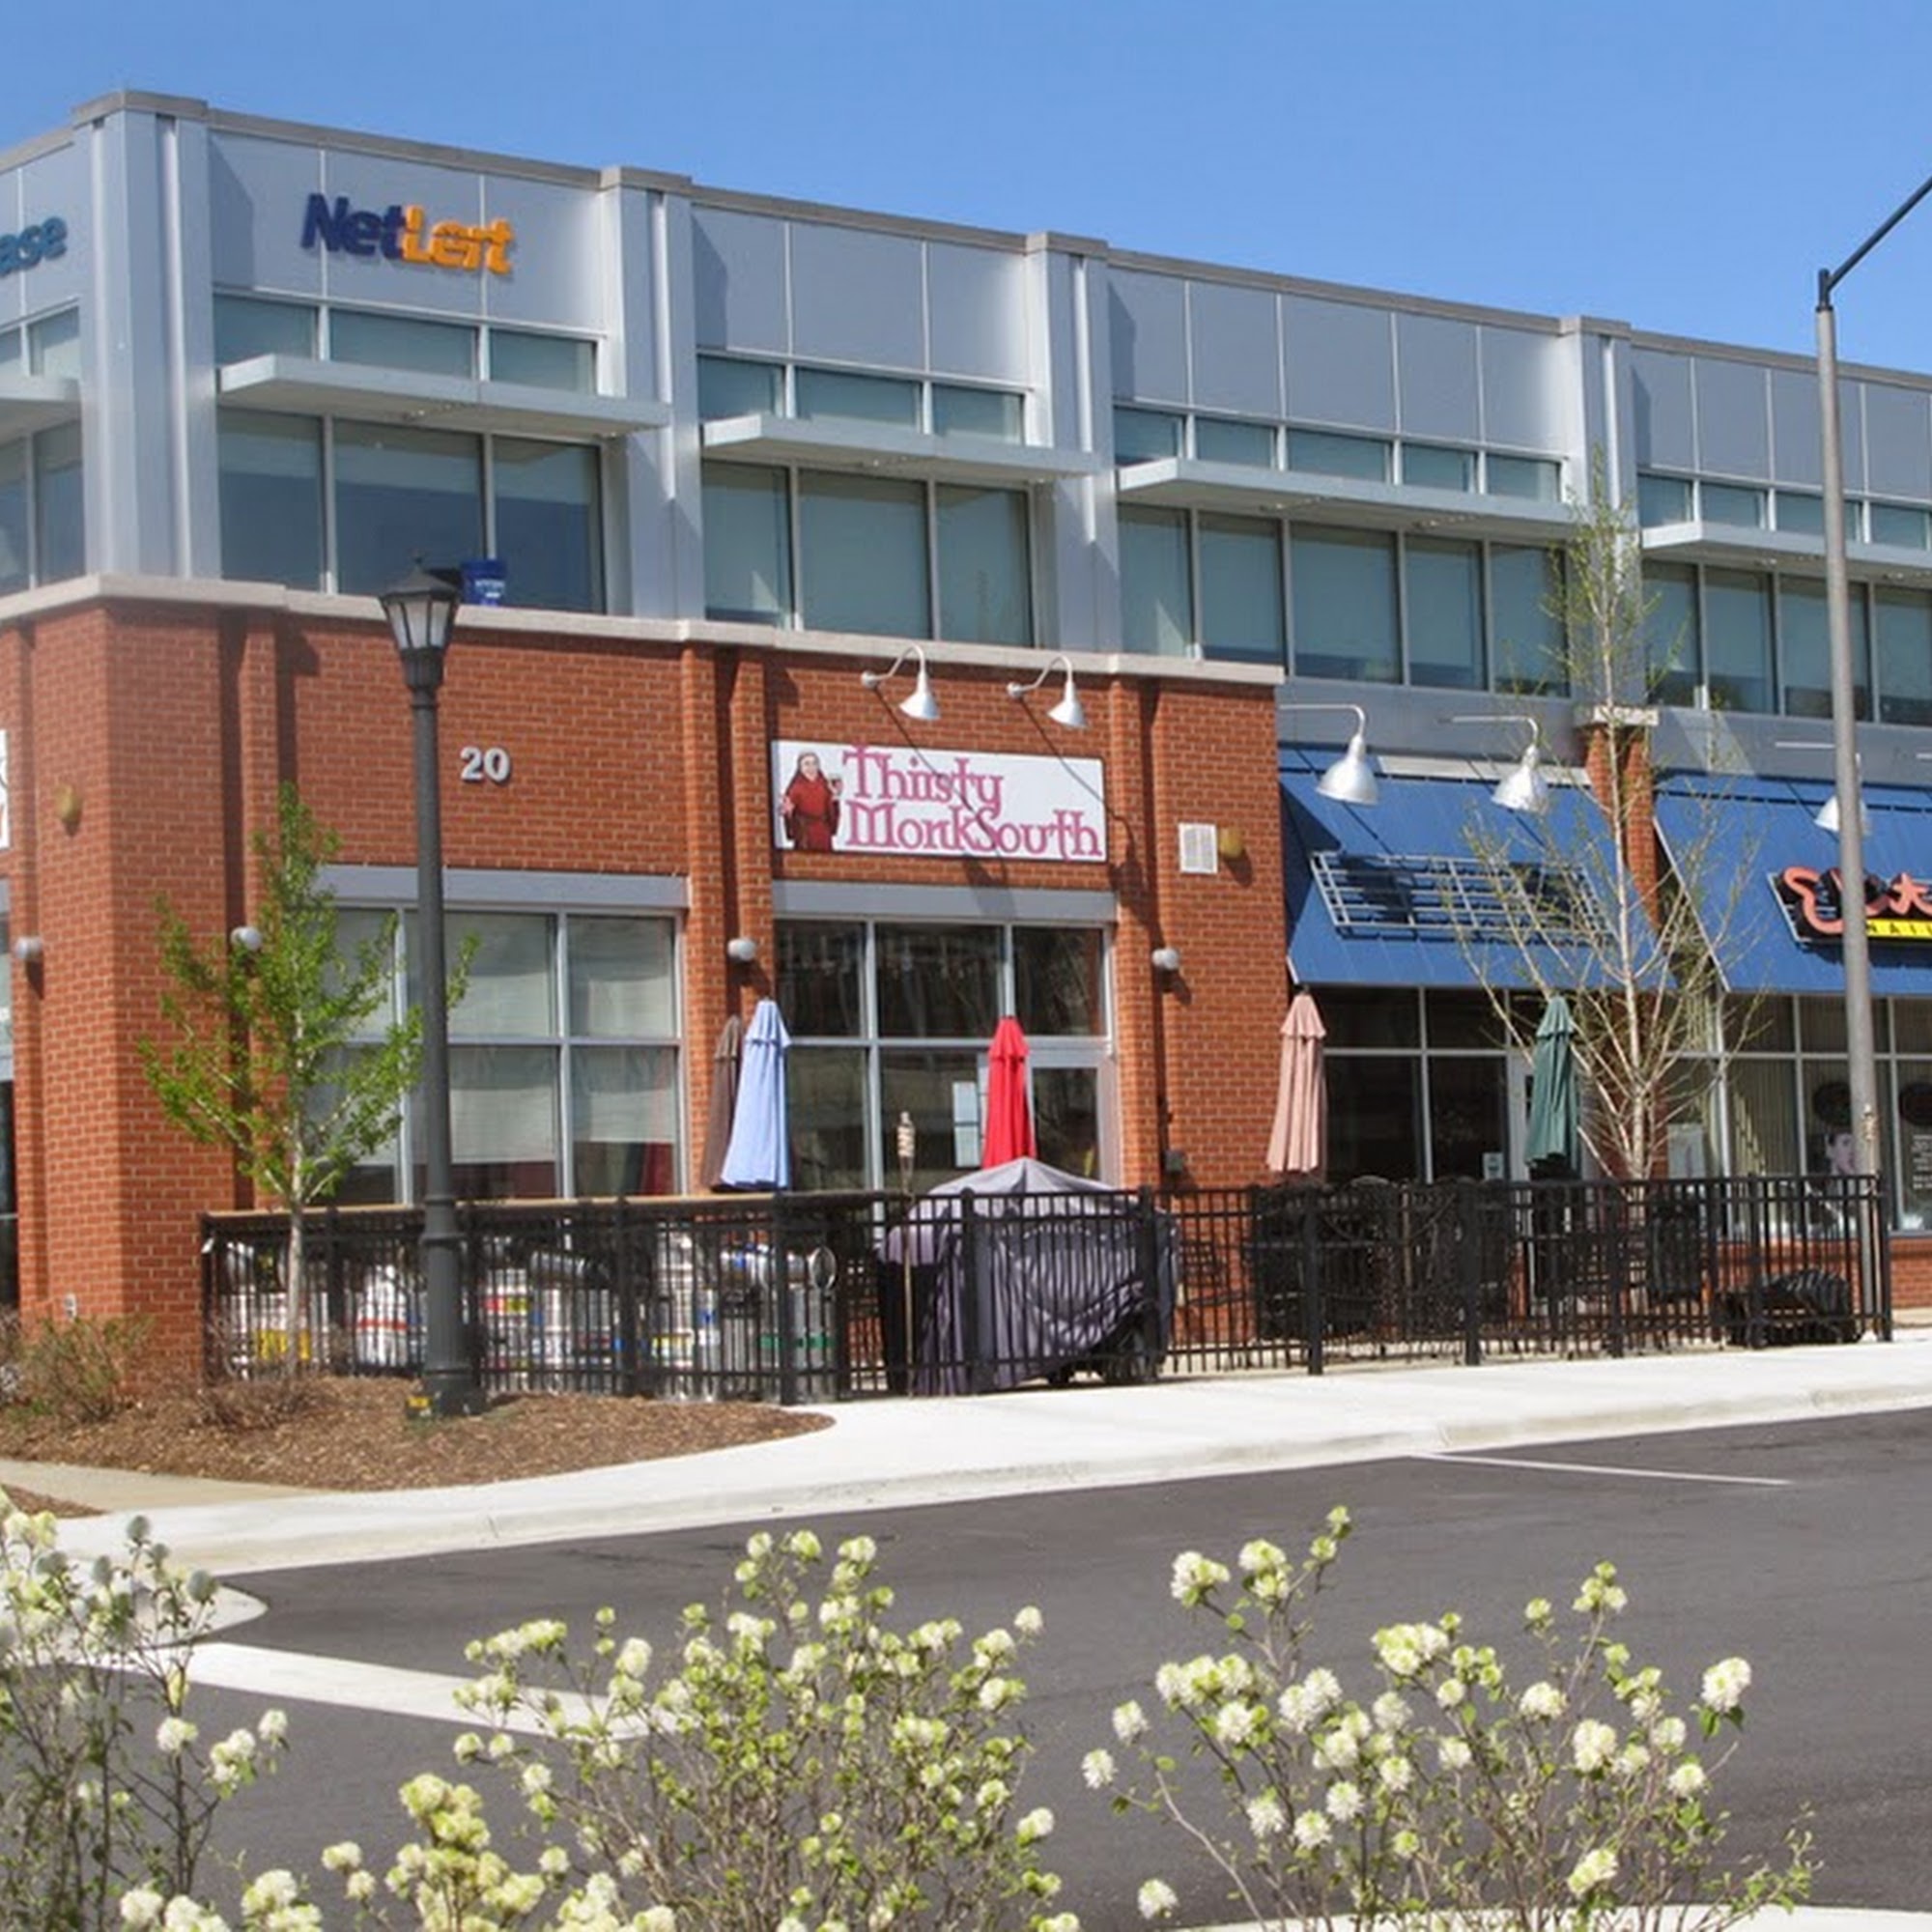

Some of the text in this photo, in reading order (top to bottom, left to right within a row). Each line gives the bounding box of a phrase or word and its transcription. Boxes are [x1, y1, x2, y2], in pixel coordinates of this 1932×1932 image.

[300, 192, 513, 274] NetLert
[460, 746, 510, 782] 20
[842, 742, 1004, 820] Thirsty
